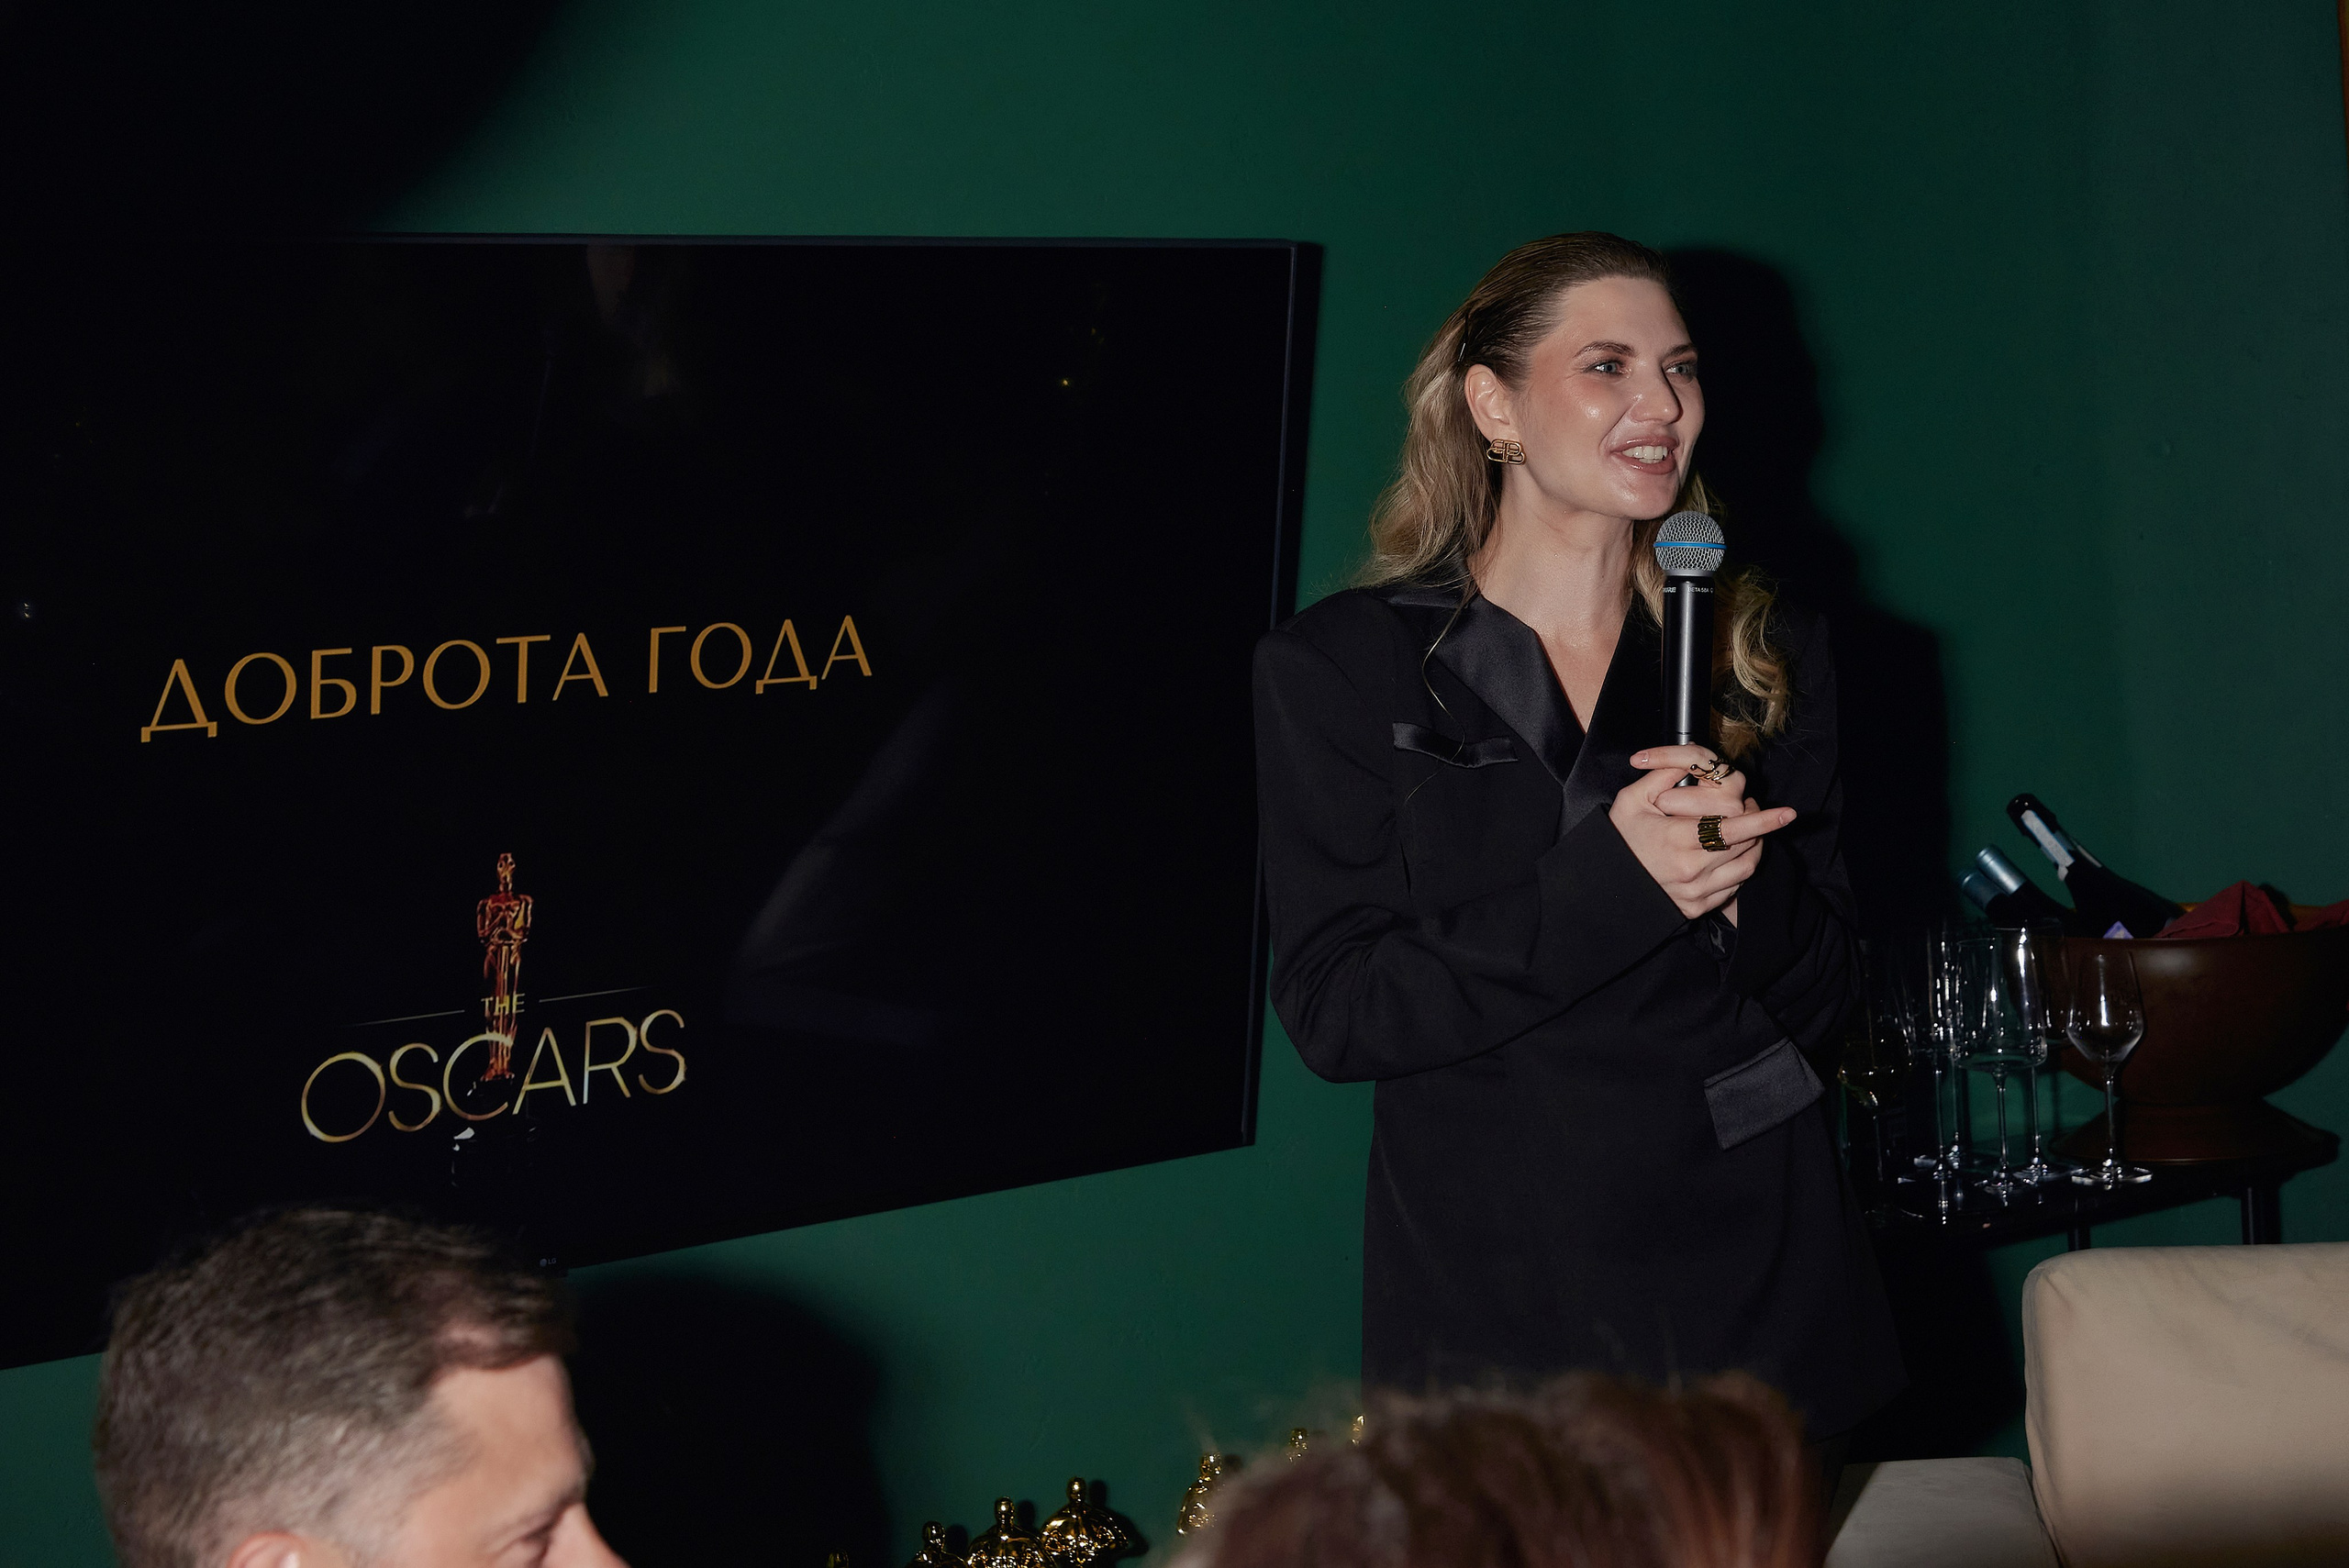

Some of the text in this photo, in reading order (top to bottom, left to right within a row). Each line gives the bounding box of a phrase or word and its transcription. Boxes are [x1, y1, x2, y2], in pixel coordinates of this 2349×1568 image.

[140, 615, 873, 743] ДОБРОТА ГОДА
[480, 993, 526, 1016] THE
[301, 1009, 687, 1143] OSCARS
